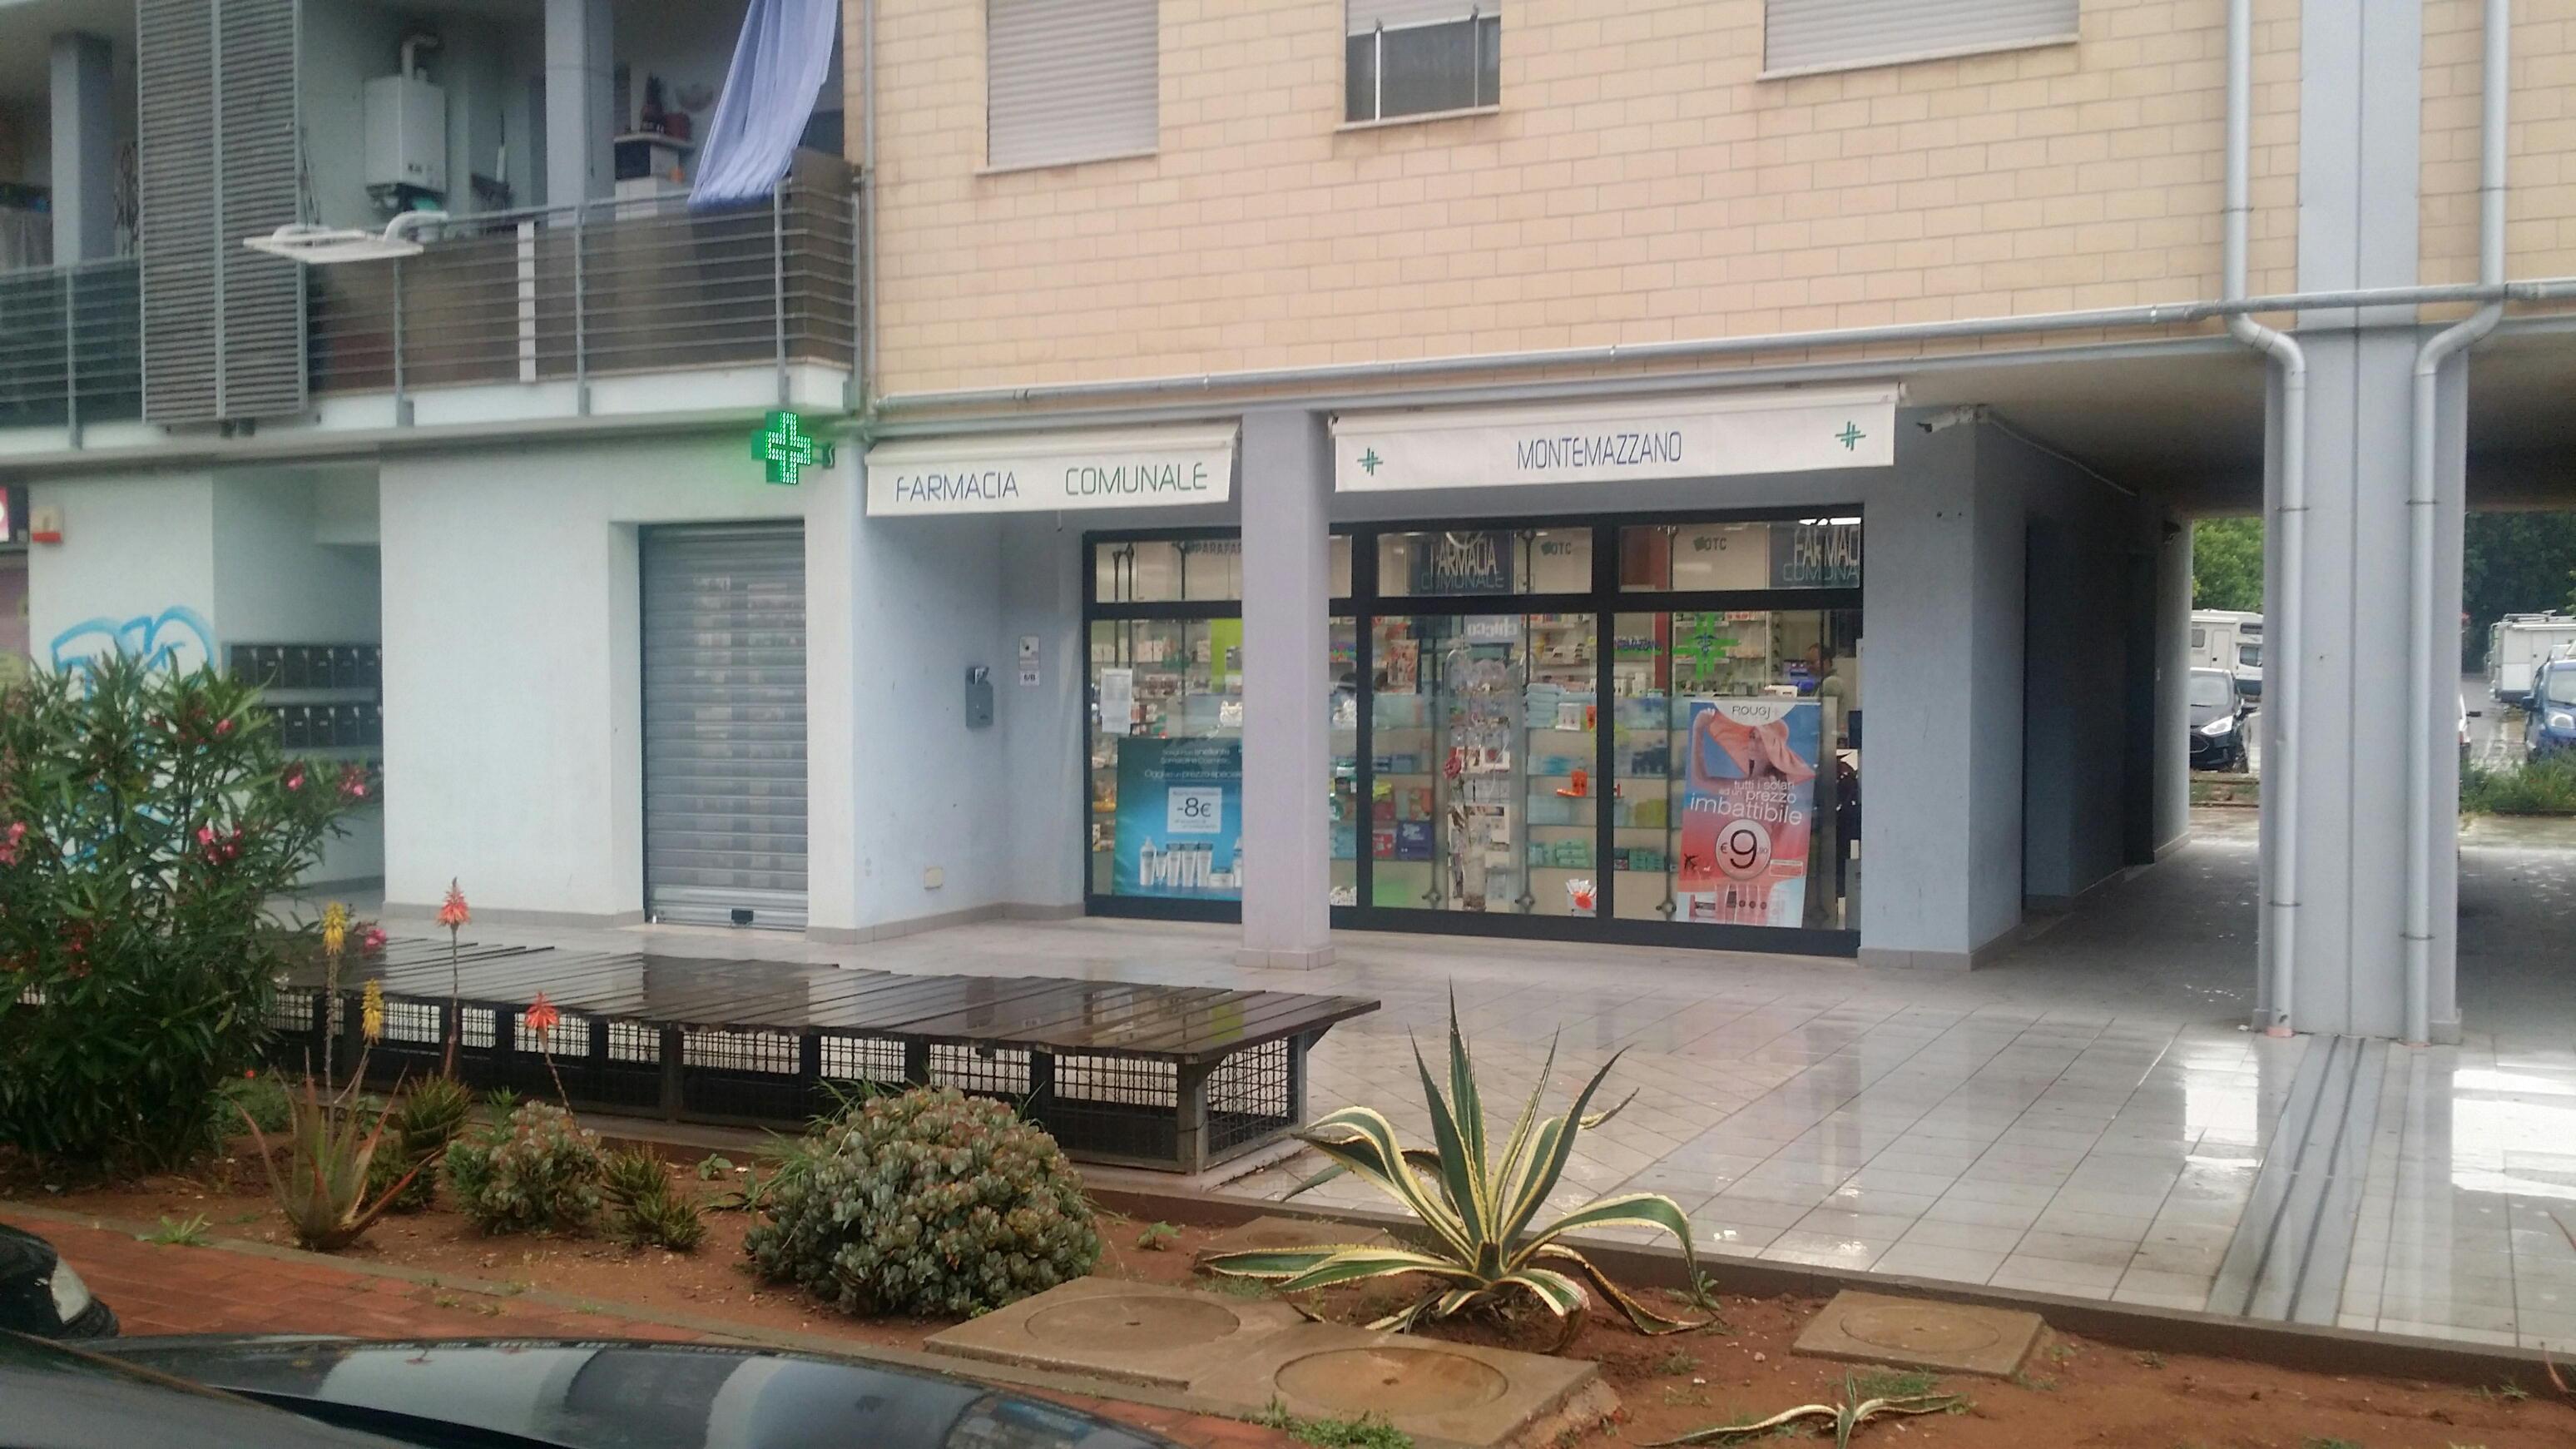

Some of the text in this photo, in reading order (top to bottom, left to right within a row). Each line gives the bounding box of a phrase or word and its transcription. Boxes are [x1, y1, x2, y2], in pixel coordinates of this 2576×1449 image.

[1518, 431, 1682, 469] MONTEMAZZANO
[896, 463, 1207, 502] FARMACIA COMUNALE
[1690, 791, 1803, 826] imbattibile
[1746, 790, 1797, 804] prezzo
